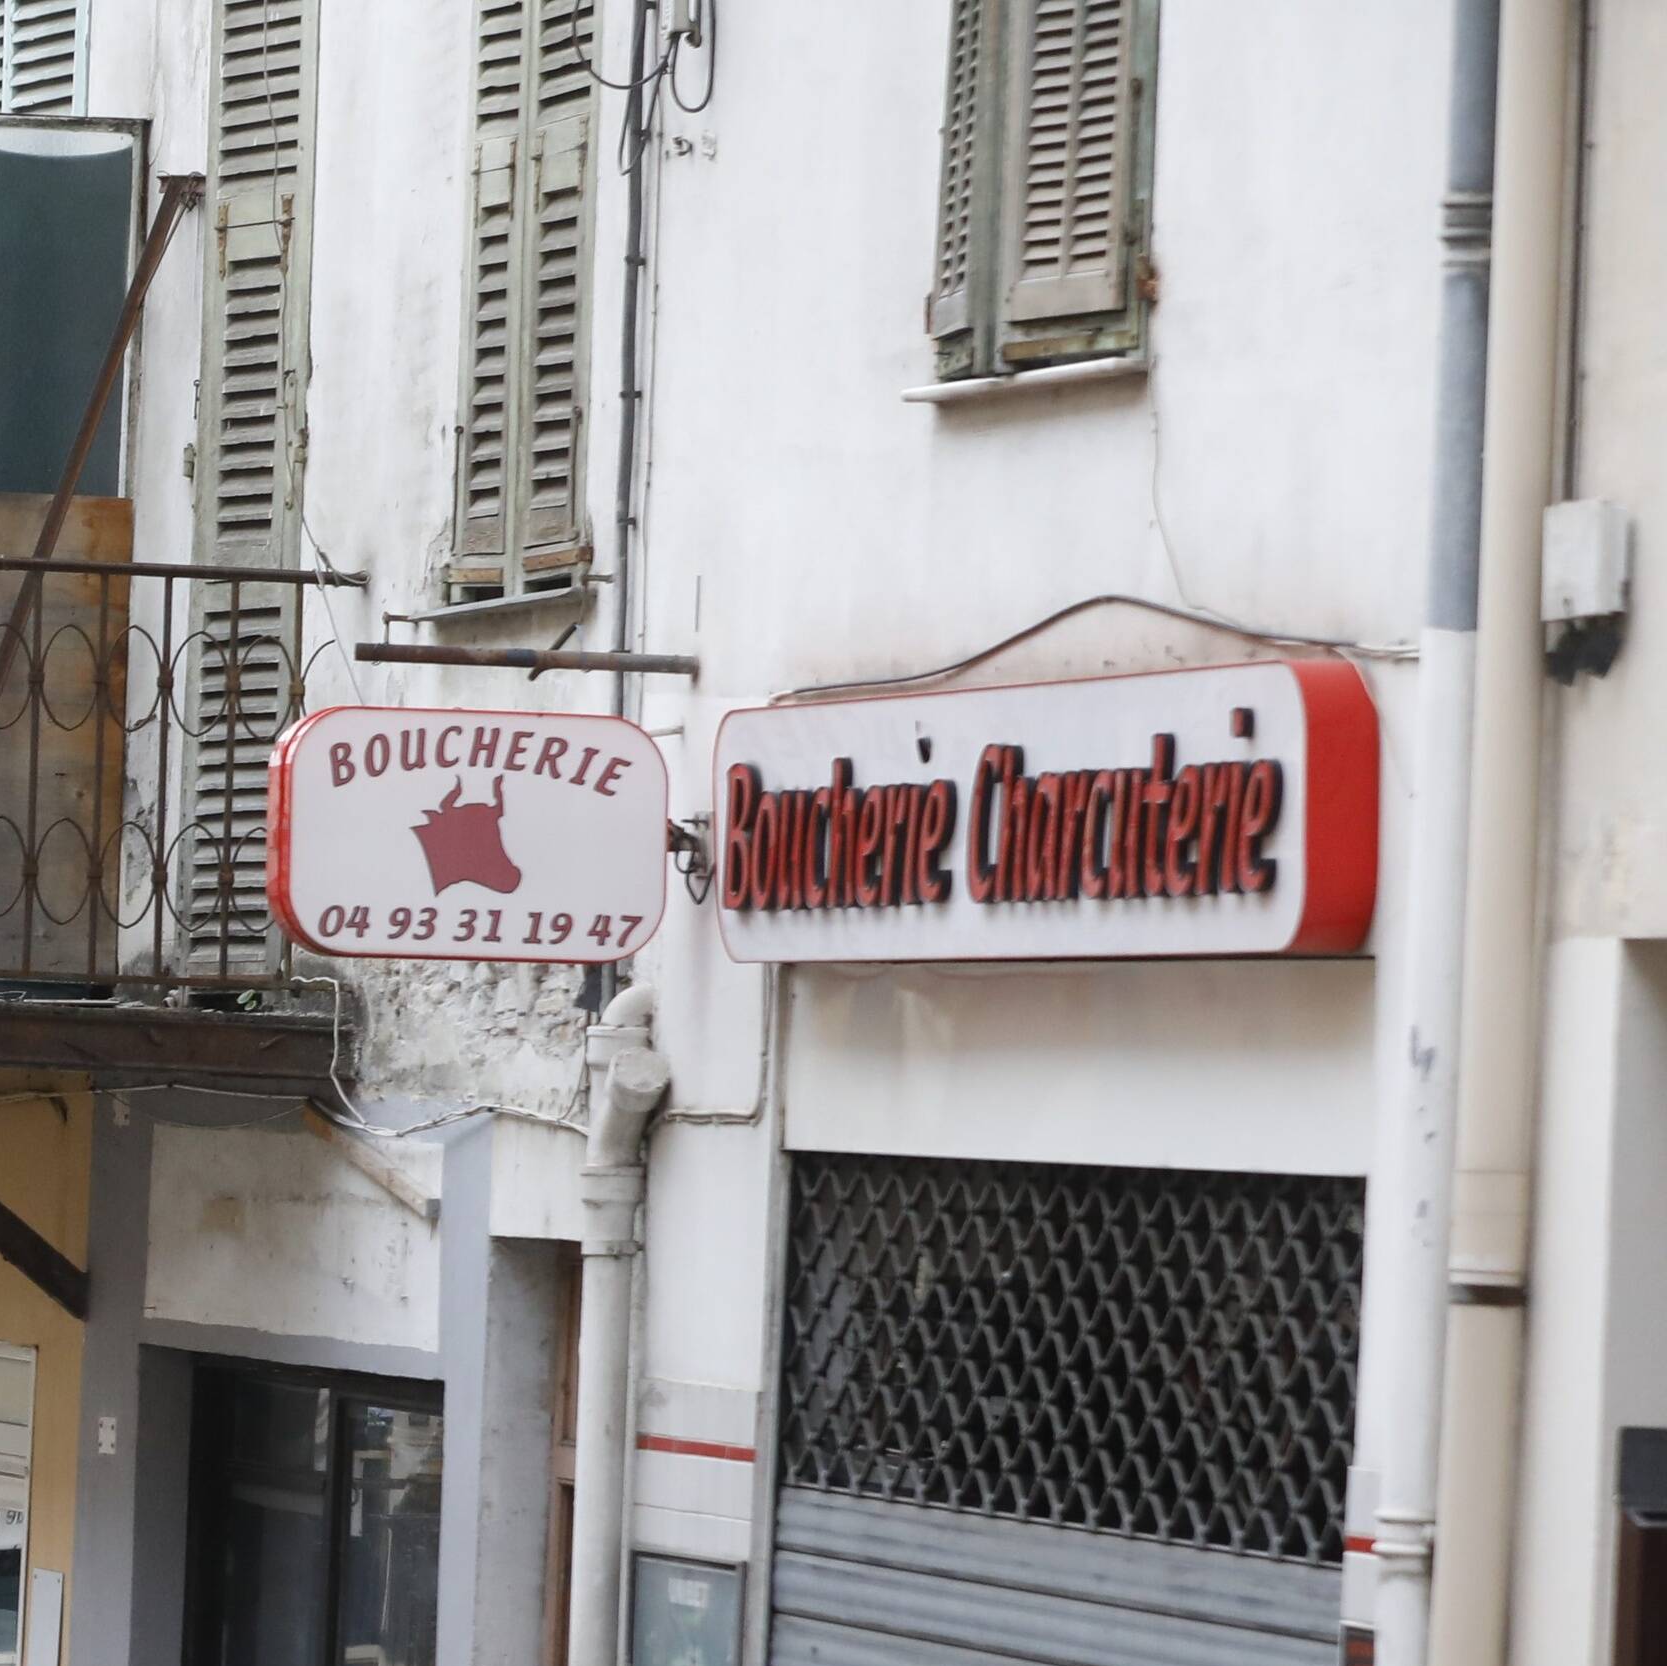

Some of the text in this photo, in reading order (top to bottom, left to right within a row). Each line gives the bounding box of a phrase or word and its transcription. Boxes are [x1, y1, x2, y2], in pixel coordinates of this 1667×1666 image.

[329, 725, 634, 797] BOUCHERIE
[723, 708, 1283, 911] Boucherie Charcuterie
[318, 905, 644, 948] 04 93 31 19 47
